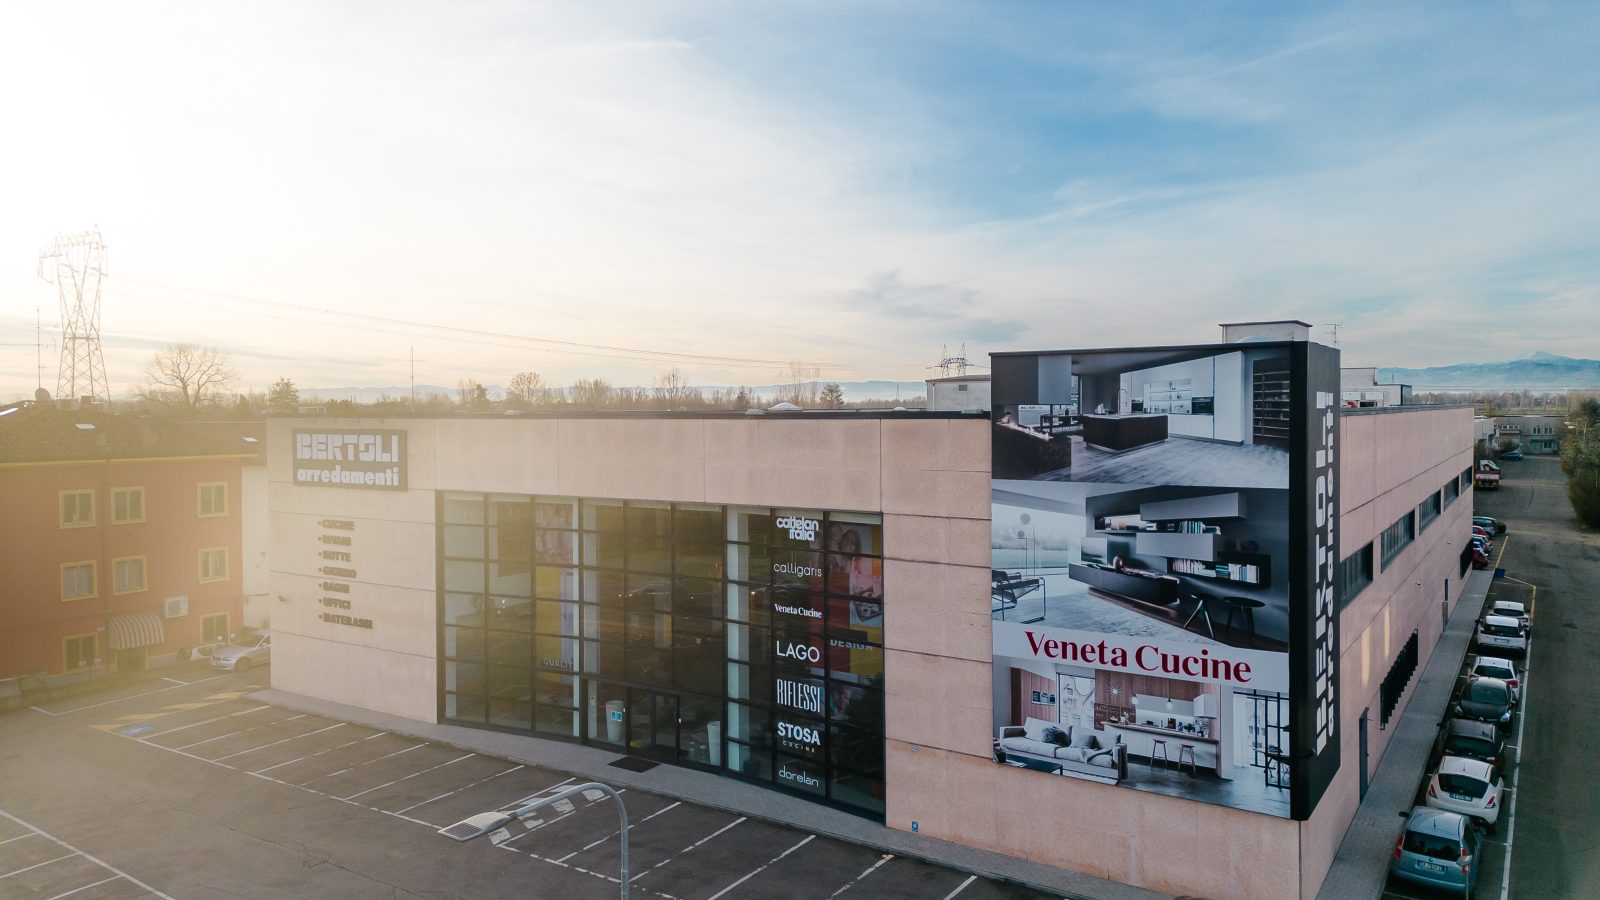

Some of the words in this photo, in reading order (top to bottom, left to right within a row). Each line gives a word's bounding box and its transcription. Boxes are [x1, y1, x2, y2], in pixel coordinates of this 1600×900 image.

[296, 433, 399, 463] BERTOLI
[297, 464, 400, 486] arredamenti
[322, 519, 355, 531] CUCINE
[776, 516, 819, 531] cattelan
[322, 550, 352, 562] NOTTE
[1326, 392, 1334, 737] arredamenti
[323, 566, 357, 578] GIORNO
[773, 561, 822, 578] calligaris
[1316, 392, 1327, 756] BERTOLI
[323, 597, 351, 610] UFFICI
[774, 603, 798, 616] Veneta
[798, 606, 823, 619] Cucine
[323, 612, 373, 630] MATERASSI
[776, 640, 820, 663] LAGO
[1024, 631, 1128, 668] Veneta
[1135, 645, 1252, 683] Cucine
[543, 656, 573, 670] QUALIT
[776, 678, 821, 713] RIFLESSI
[777, 722, 821, 746] STOSA
[782, 740, 815, 753] CUCINE
[778, 765, 819, 787] dorelan
